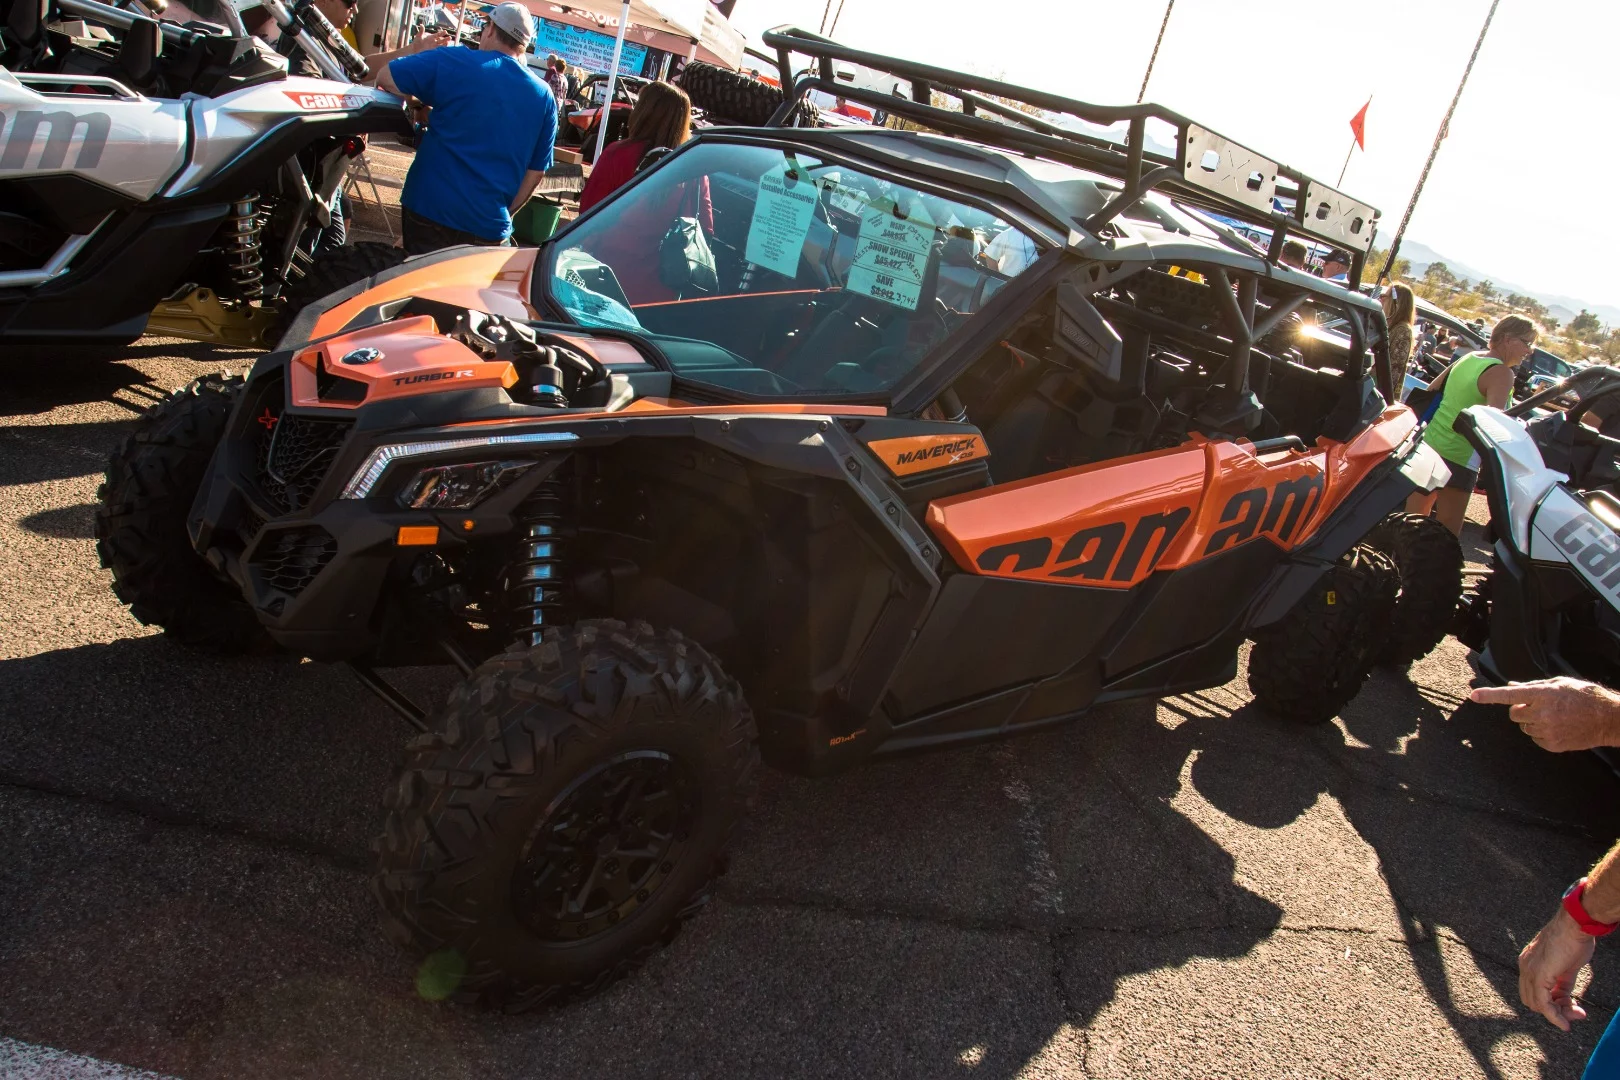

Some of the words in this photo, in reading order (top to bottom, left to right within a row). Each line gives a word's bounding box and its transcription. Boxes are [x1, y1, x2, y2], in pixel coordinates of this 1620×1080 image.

[299, 94, 374, 109] can-am
[783, 188, 815, 204] Accessories
[869, 241, 889, 254] SHOW
[890, 247, 915, 263] SPECIAL
[876, 274, 895, 287] SAVE
[896, 437, 978, 466] MAVERICK
